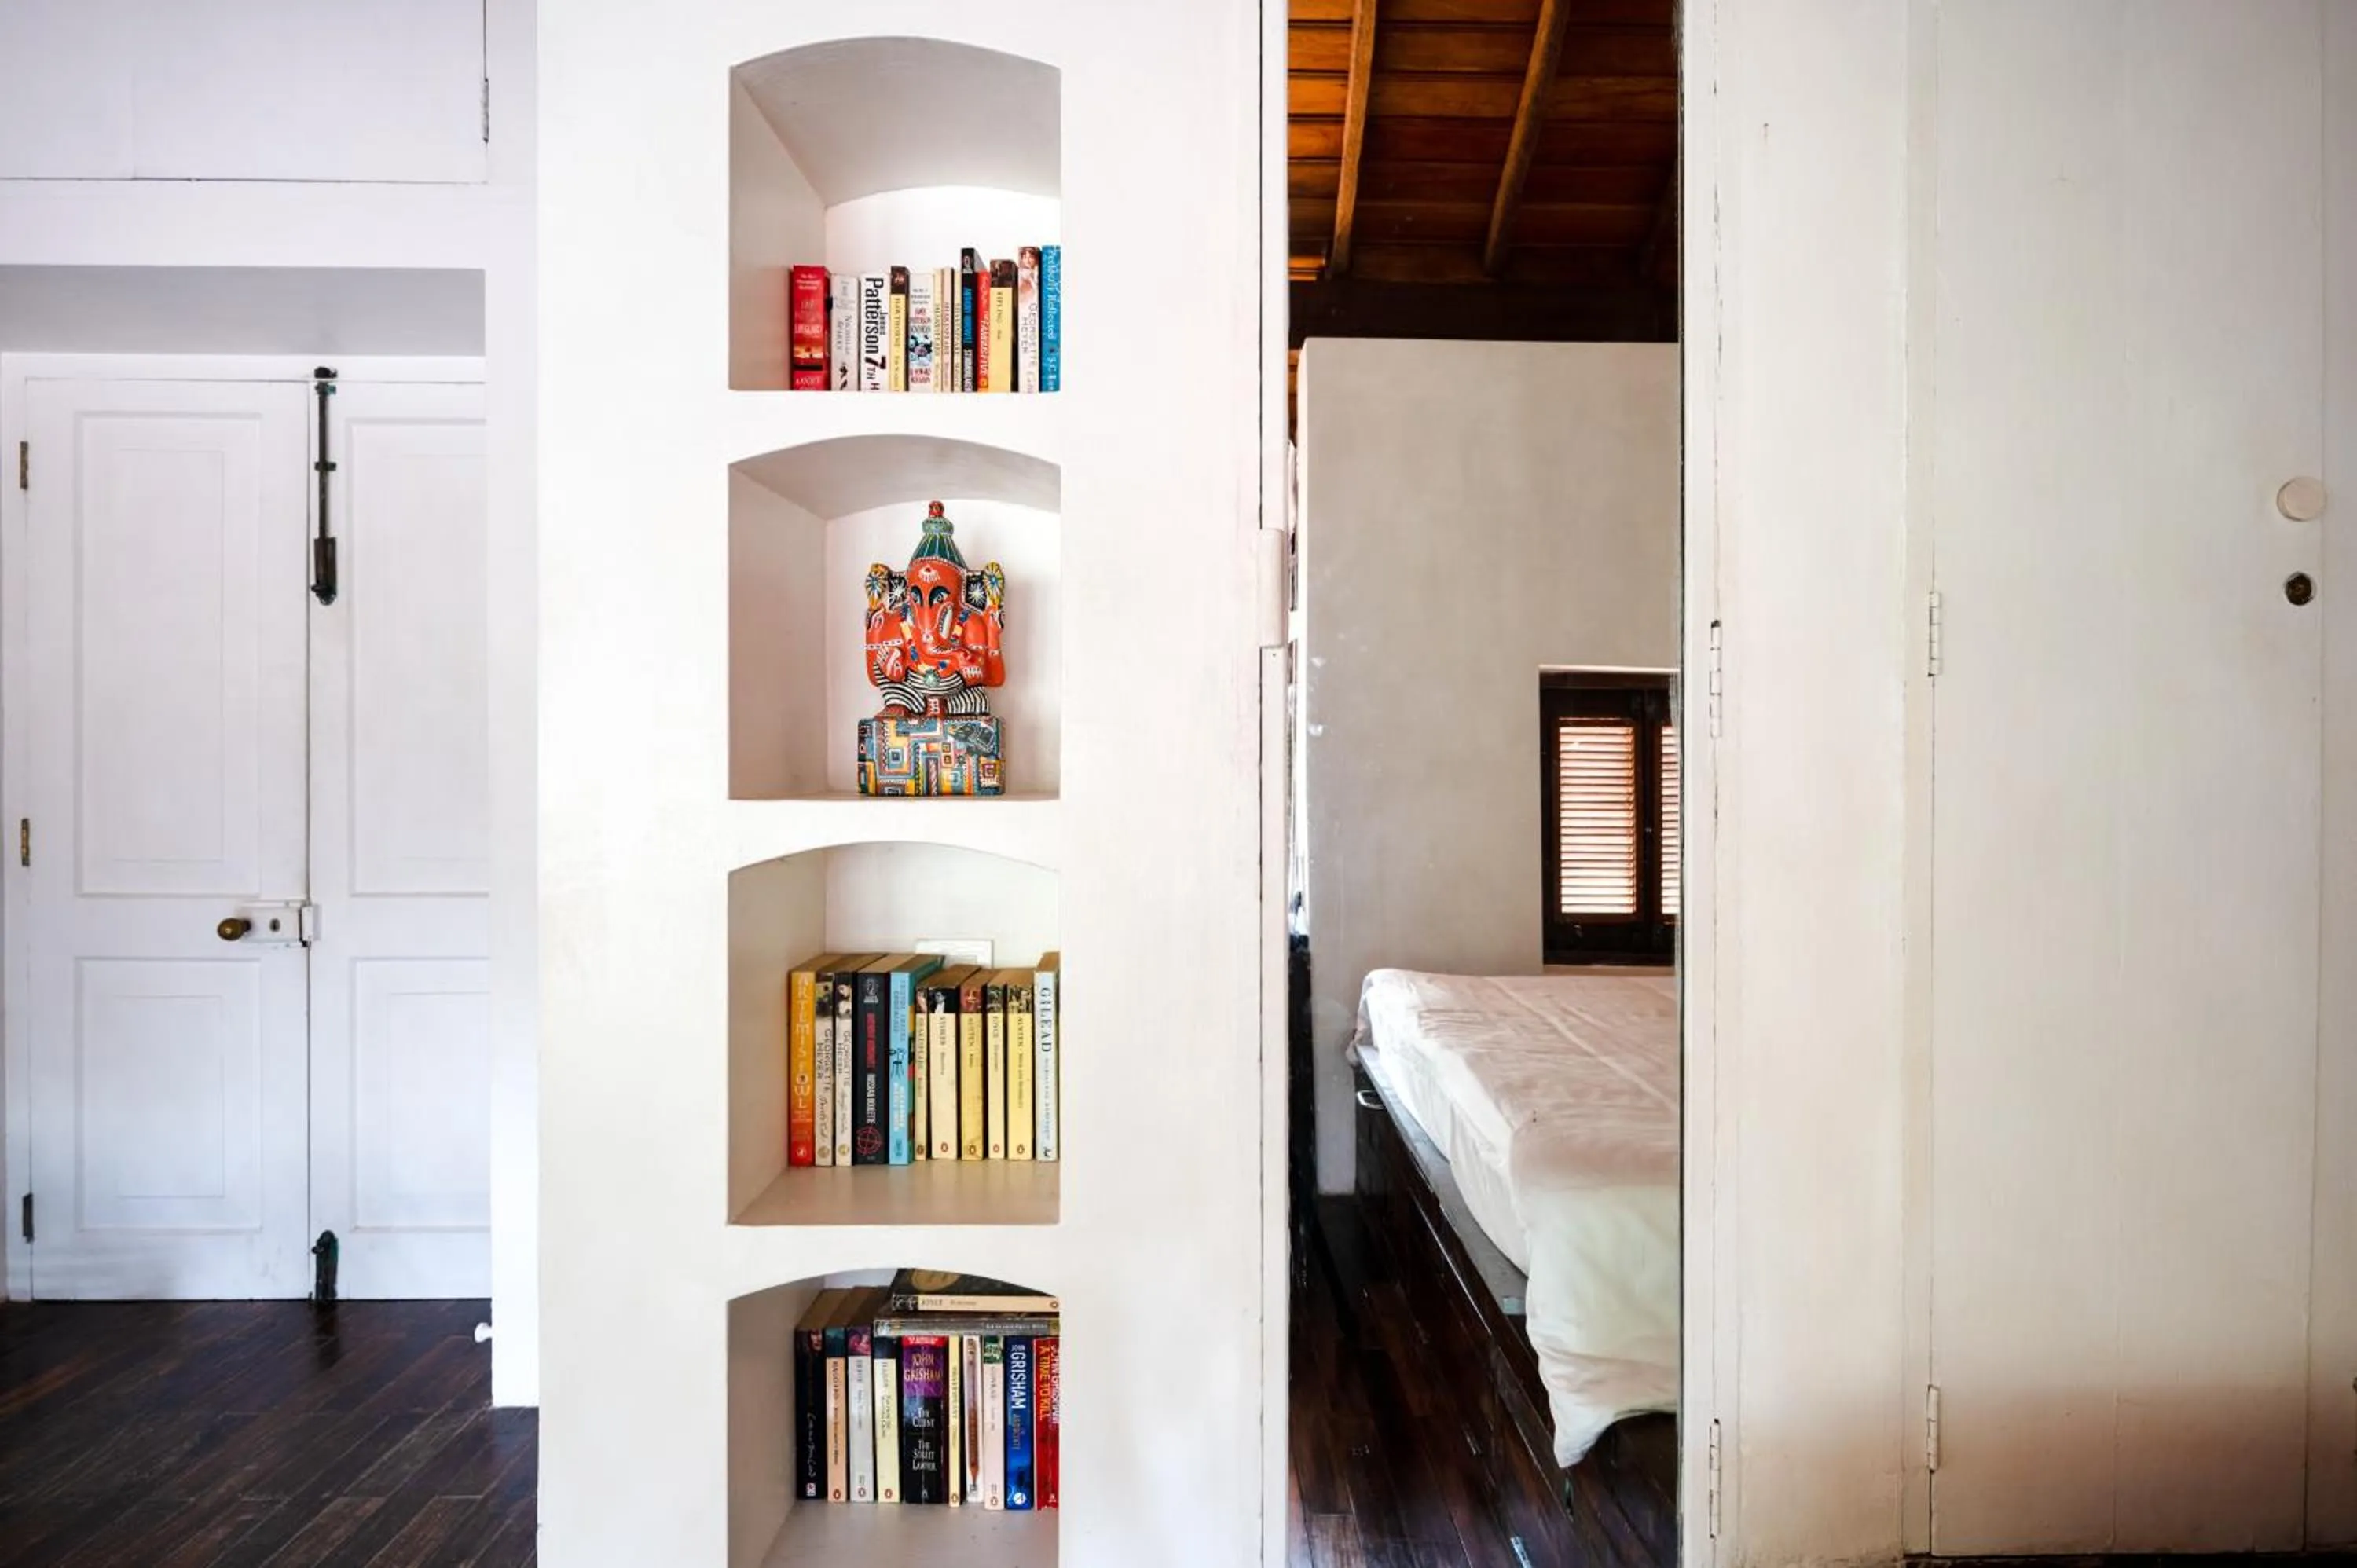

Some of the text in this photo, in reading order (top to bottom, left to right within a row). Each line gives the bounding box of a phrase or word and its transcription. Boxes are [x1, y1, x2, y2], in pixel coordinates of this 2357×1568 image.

[865, 278, 884, 354] Patterson
[1040, 987, 1053, 1053] GILEAD
[904, 1368, 941, 1382] GRISHAM
[911, 1353, 934, 1366] JOHN
[1010, 1352, 1027, 1409] GRISHAM
[1039, 1346, 1050, 1420] A TIME TO KILL
